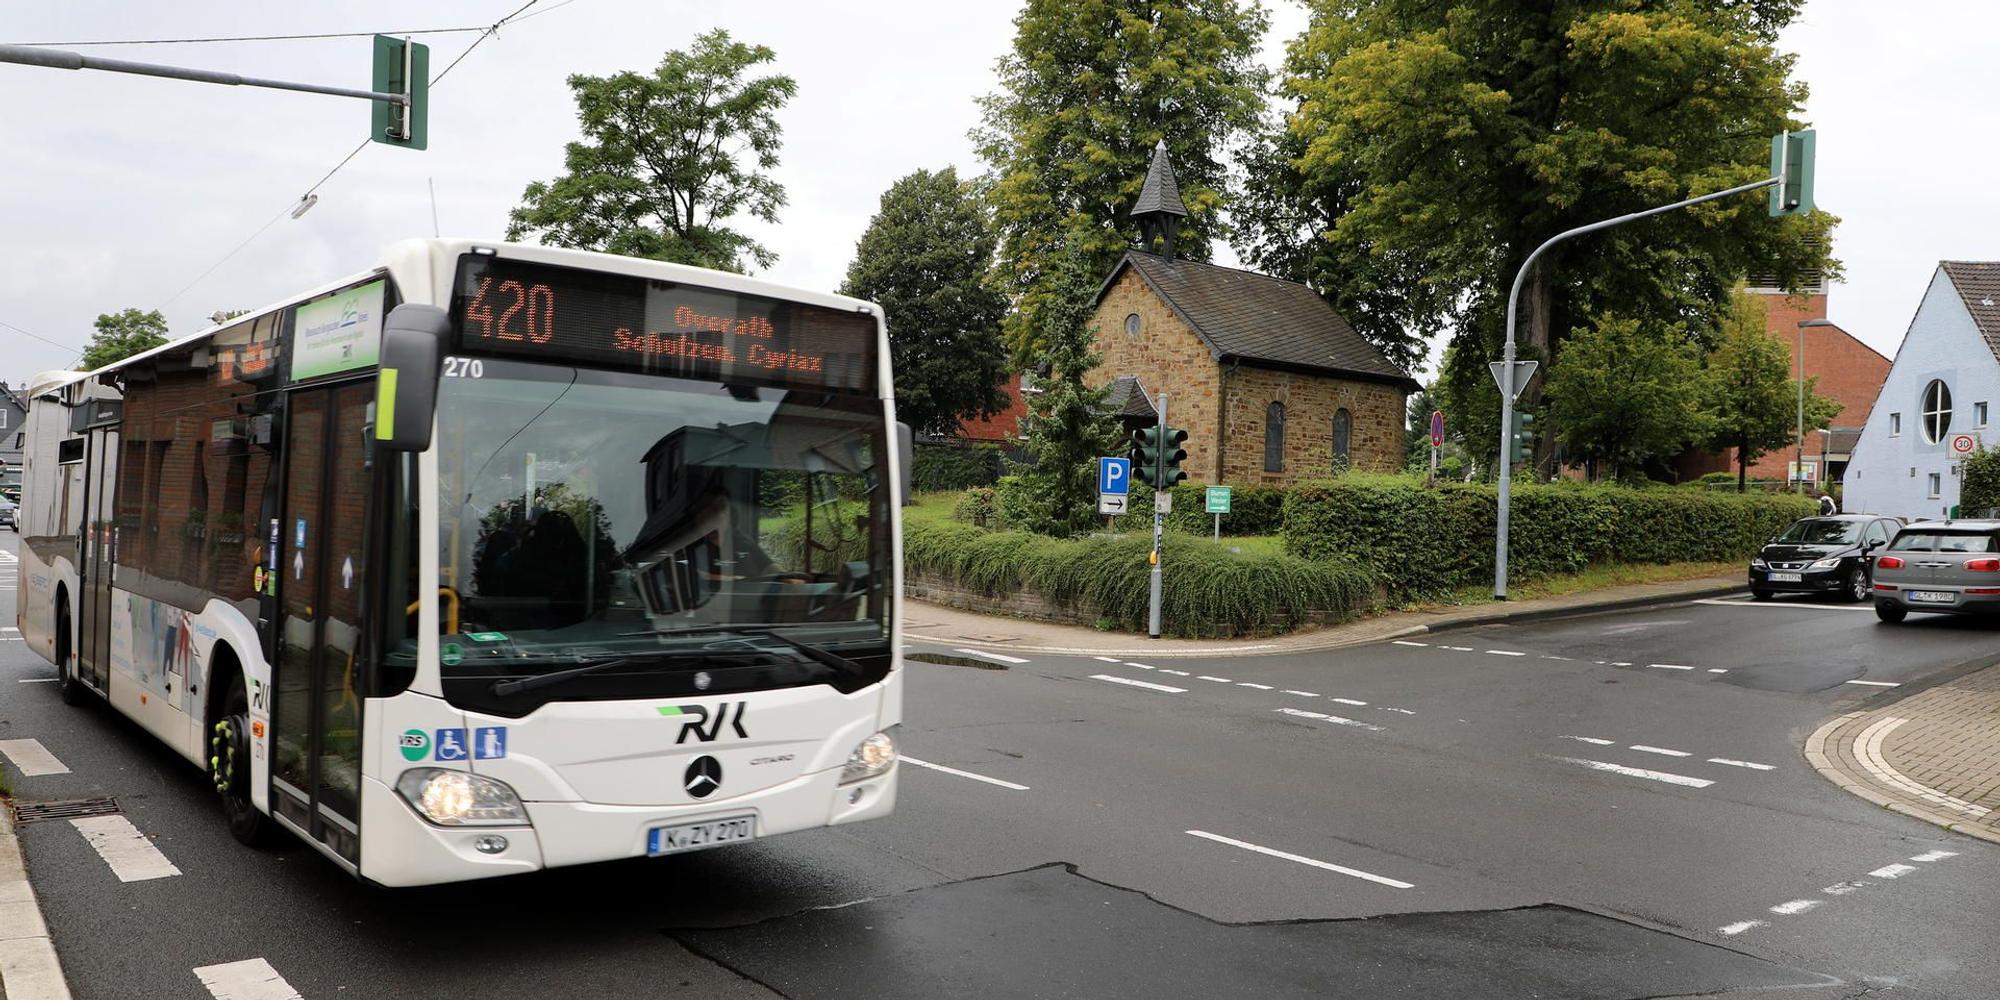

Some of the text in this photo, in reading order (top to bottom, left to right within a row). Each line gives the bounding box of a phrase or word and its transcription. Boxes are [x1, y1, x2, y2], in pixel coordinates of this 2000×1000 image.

[467, 277, 555, 343] 420
[673, 306, 774, 338] Overath
[443, 356, 484, 378] 270
[747, 343, 823, 372] Cyriax
[1957, 440, 1969, 448] 30
[1107, 462, 1123, 489] P
[665, 829, 678, 849] K
[717, 820, 749, 840] 270
